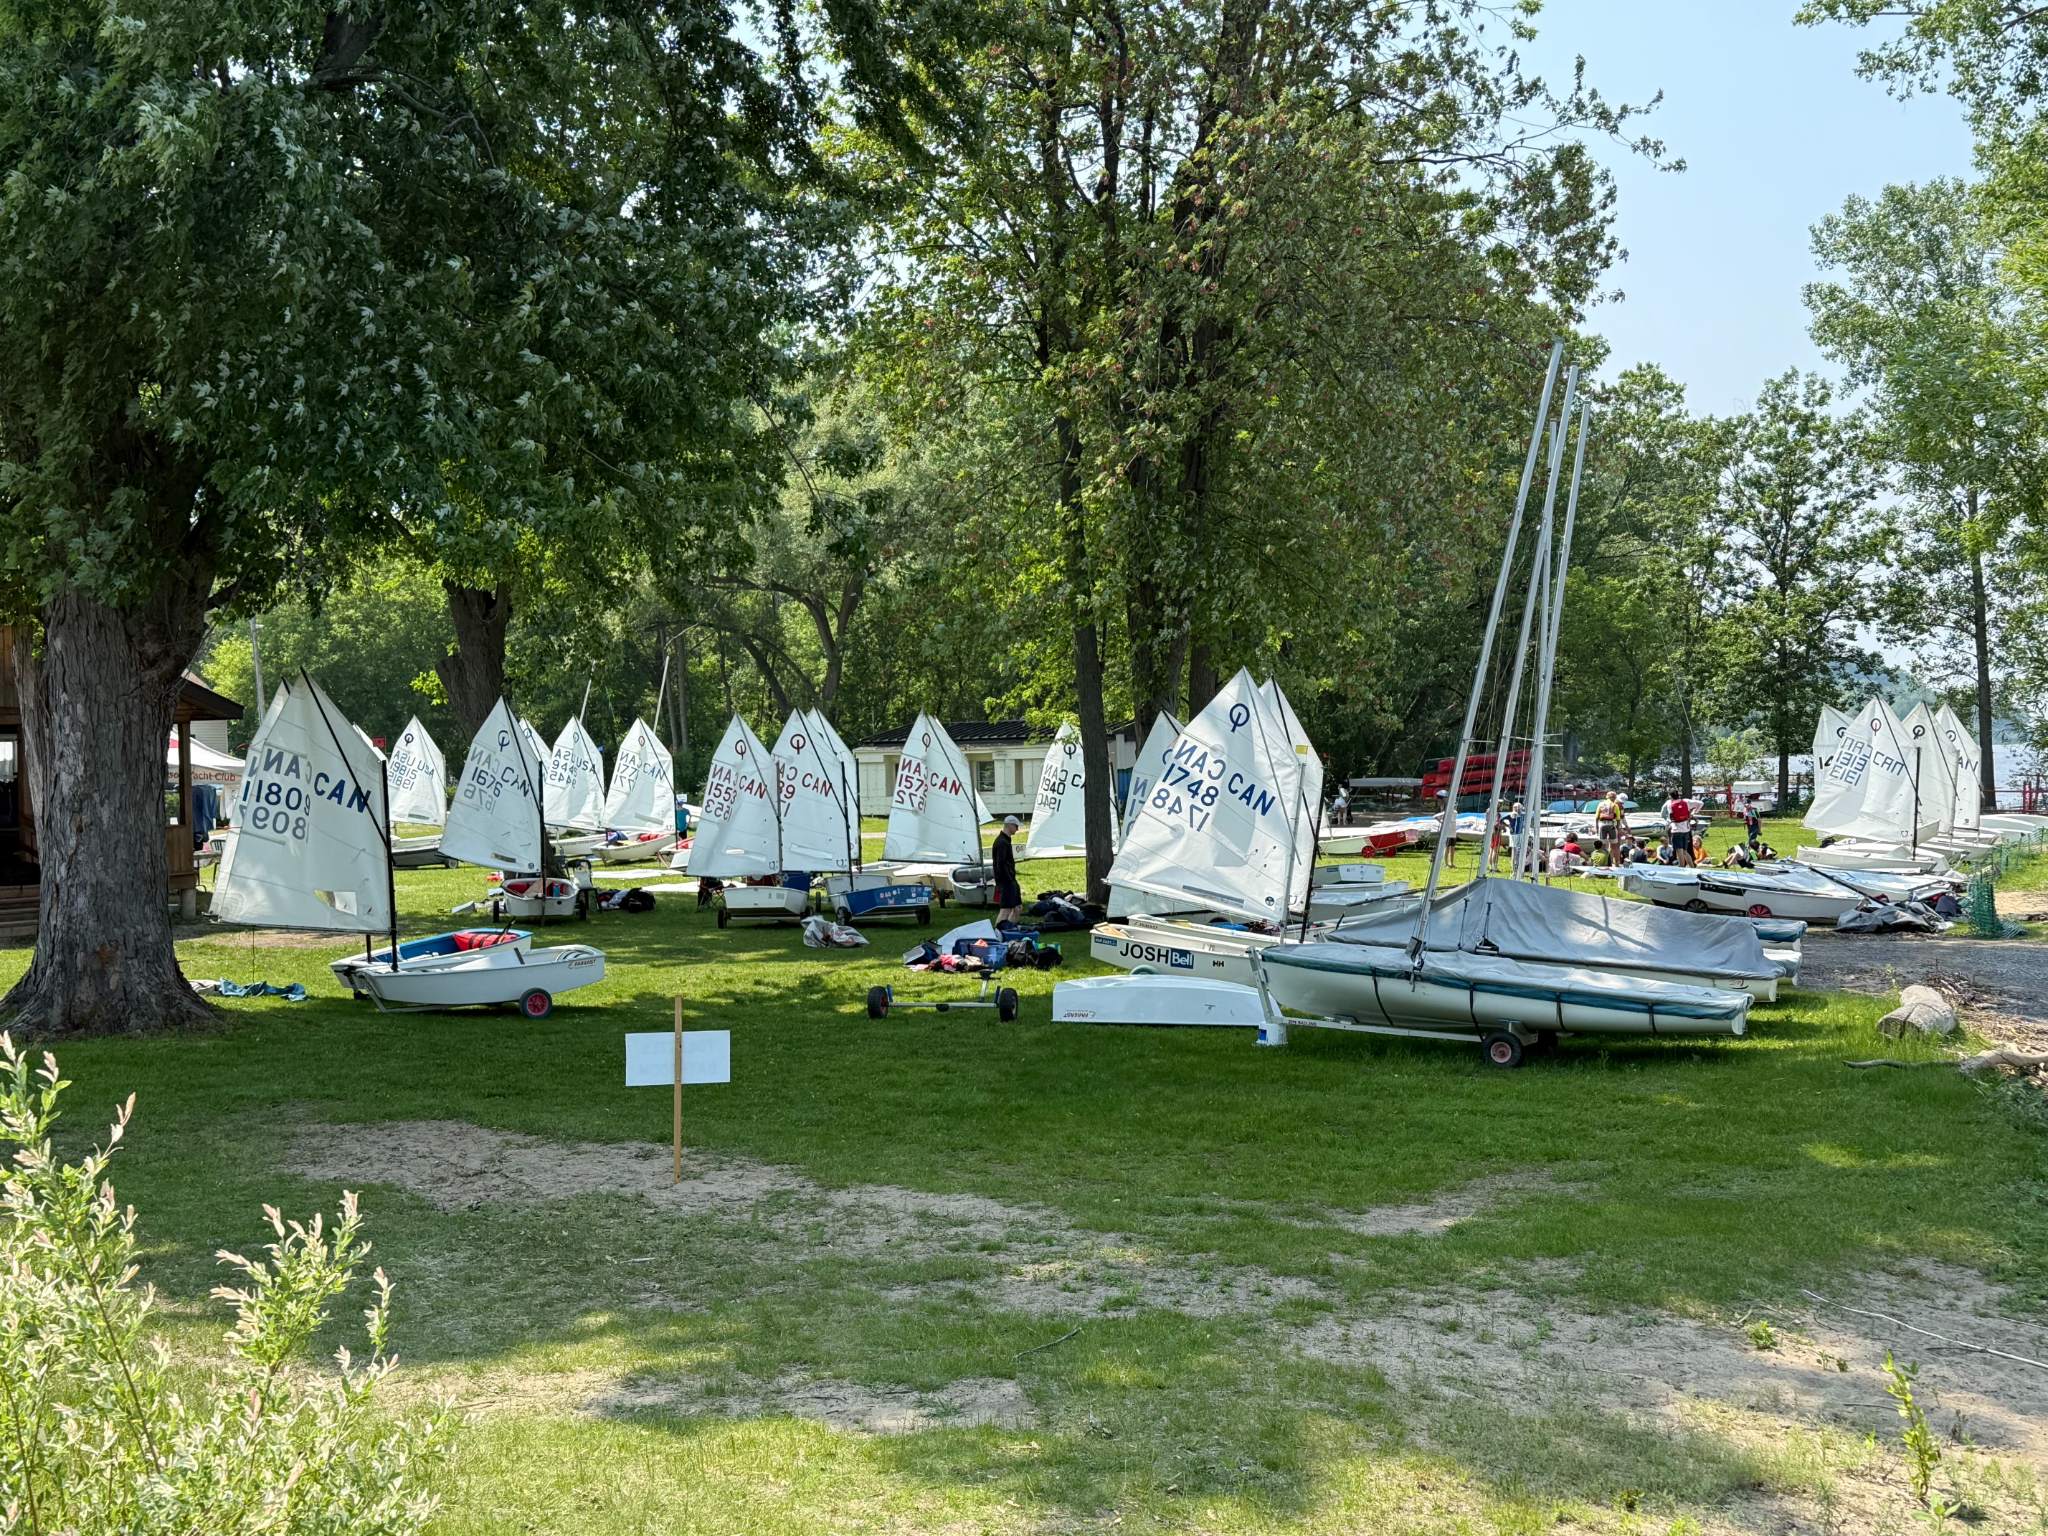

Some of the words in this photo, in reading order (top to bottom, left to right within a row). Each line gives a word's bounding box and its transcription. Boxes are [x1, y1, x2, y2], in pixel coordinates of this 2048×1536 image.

[390, 761, 418, 780] 19815
[397, 760, 434, 777] USA
[643, 763, 665, 780] CAN
[1836, 750, 1868, 772] 1313
[191, 771, 213, 780] acht
[215, 771, 235, 781] Club
[472, 767, 503, 798] 1676
[501, 766, 529, 797] CAN
[739, 776, 767, 799] CAN
[802, 773, 832, 797] CAN
[899, 774, 928, 798] 1572
[931, 773, 960, 795] CAN
[1041, 776, 1065, 795] 1940
[1162, 763, 1219, 806] 1748
[314, 772, 371, 813] CAN
[708, 782, 737, 804] 1553
[1228, 773, 1275, 816] CAN
[1120, 943, 1169, 964] JOSH
[1172, 951, 1193, 966] Bell
